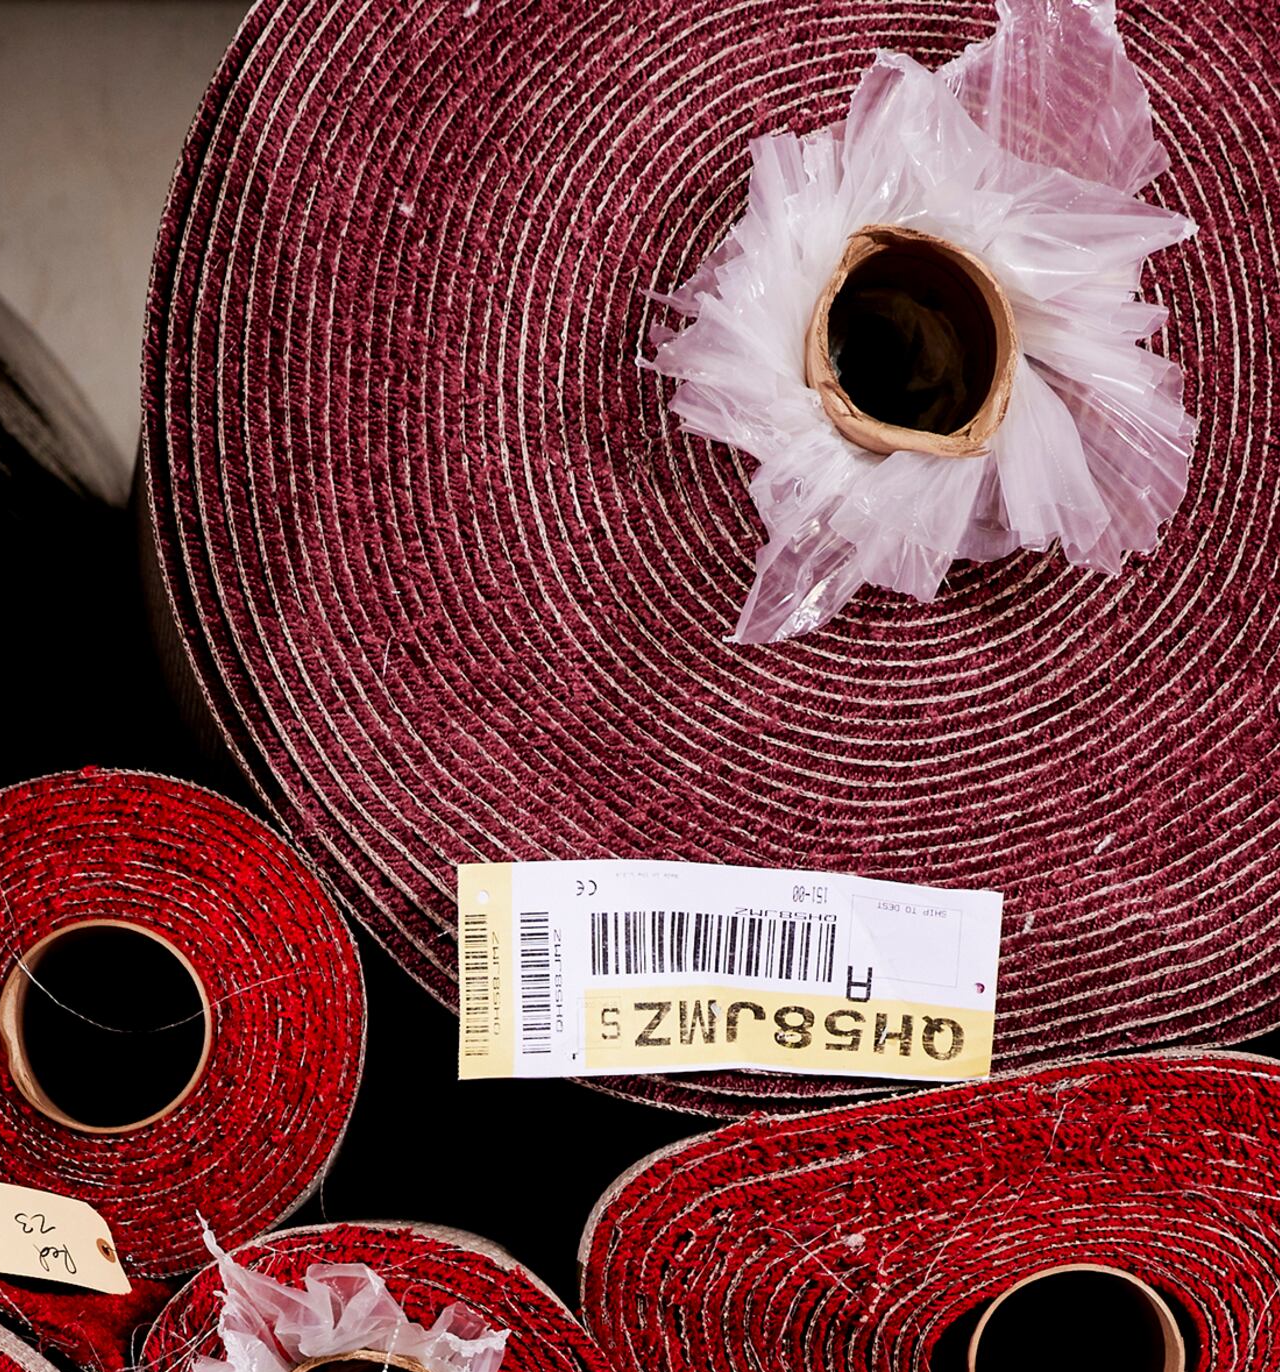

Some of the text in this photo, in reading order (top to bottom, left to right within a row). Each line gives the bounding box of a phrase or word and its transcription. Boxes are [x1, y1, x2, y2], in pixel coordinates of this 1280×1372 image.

[792, 885, 829, 904] 151-00
[734, 906, 838, 924] QH58JMZ
[876, 900, 947, 918] SHIP TO DEST
[846, 965, 874, 1003] A
[601, 998, 966, 1062] QH58JMZ S
[32, 1243, 76, 1274] Red
